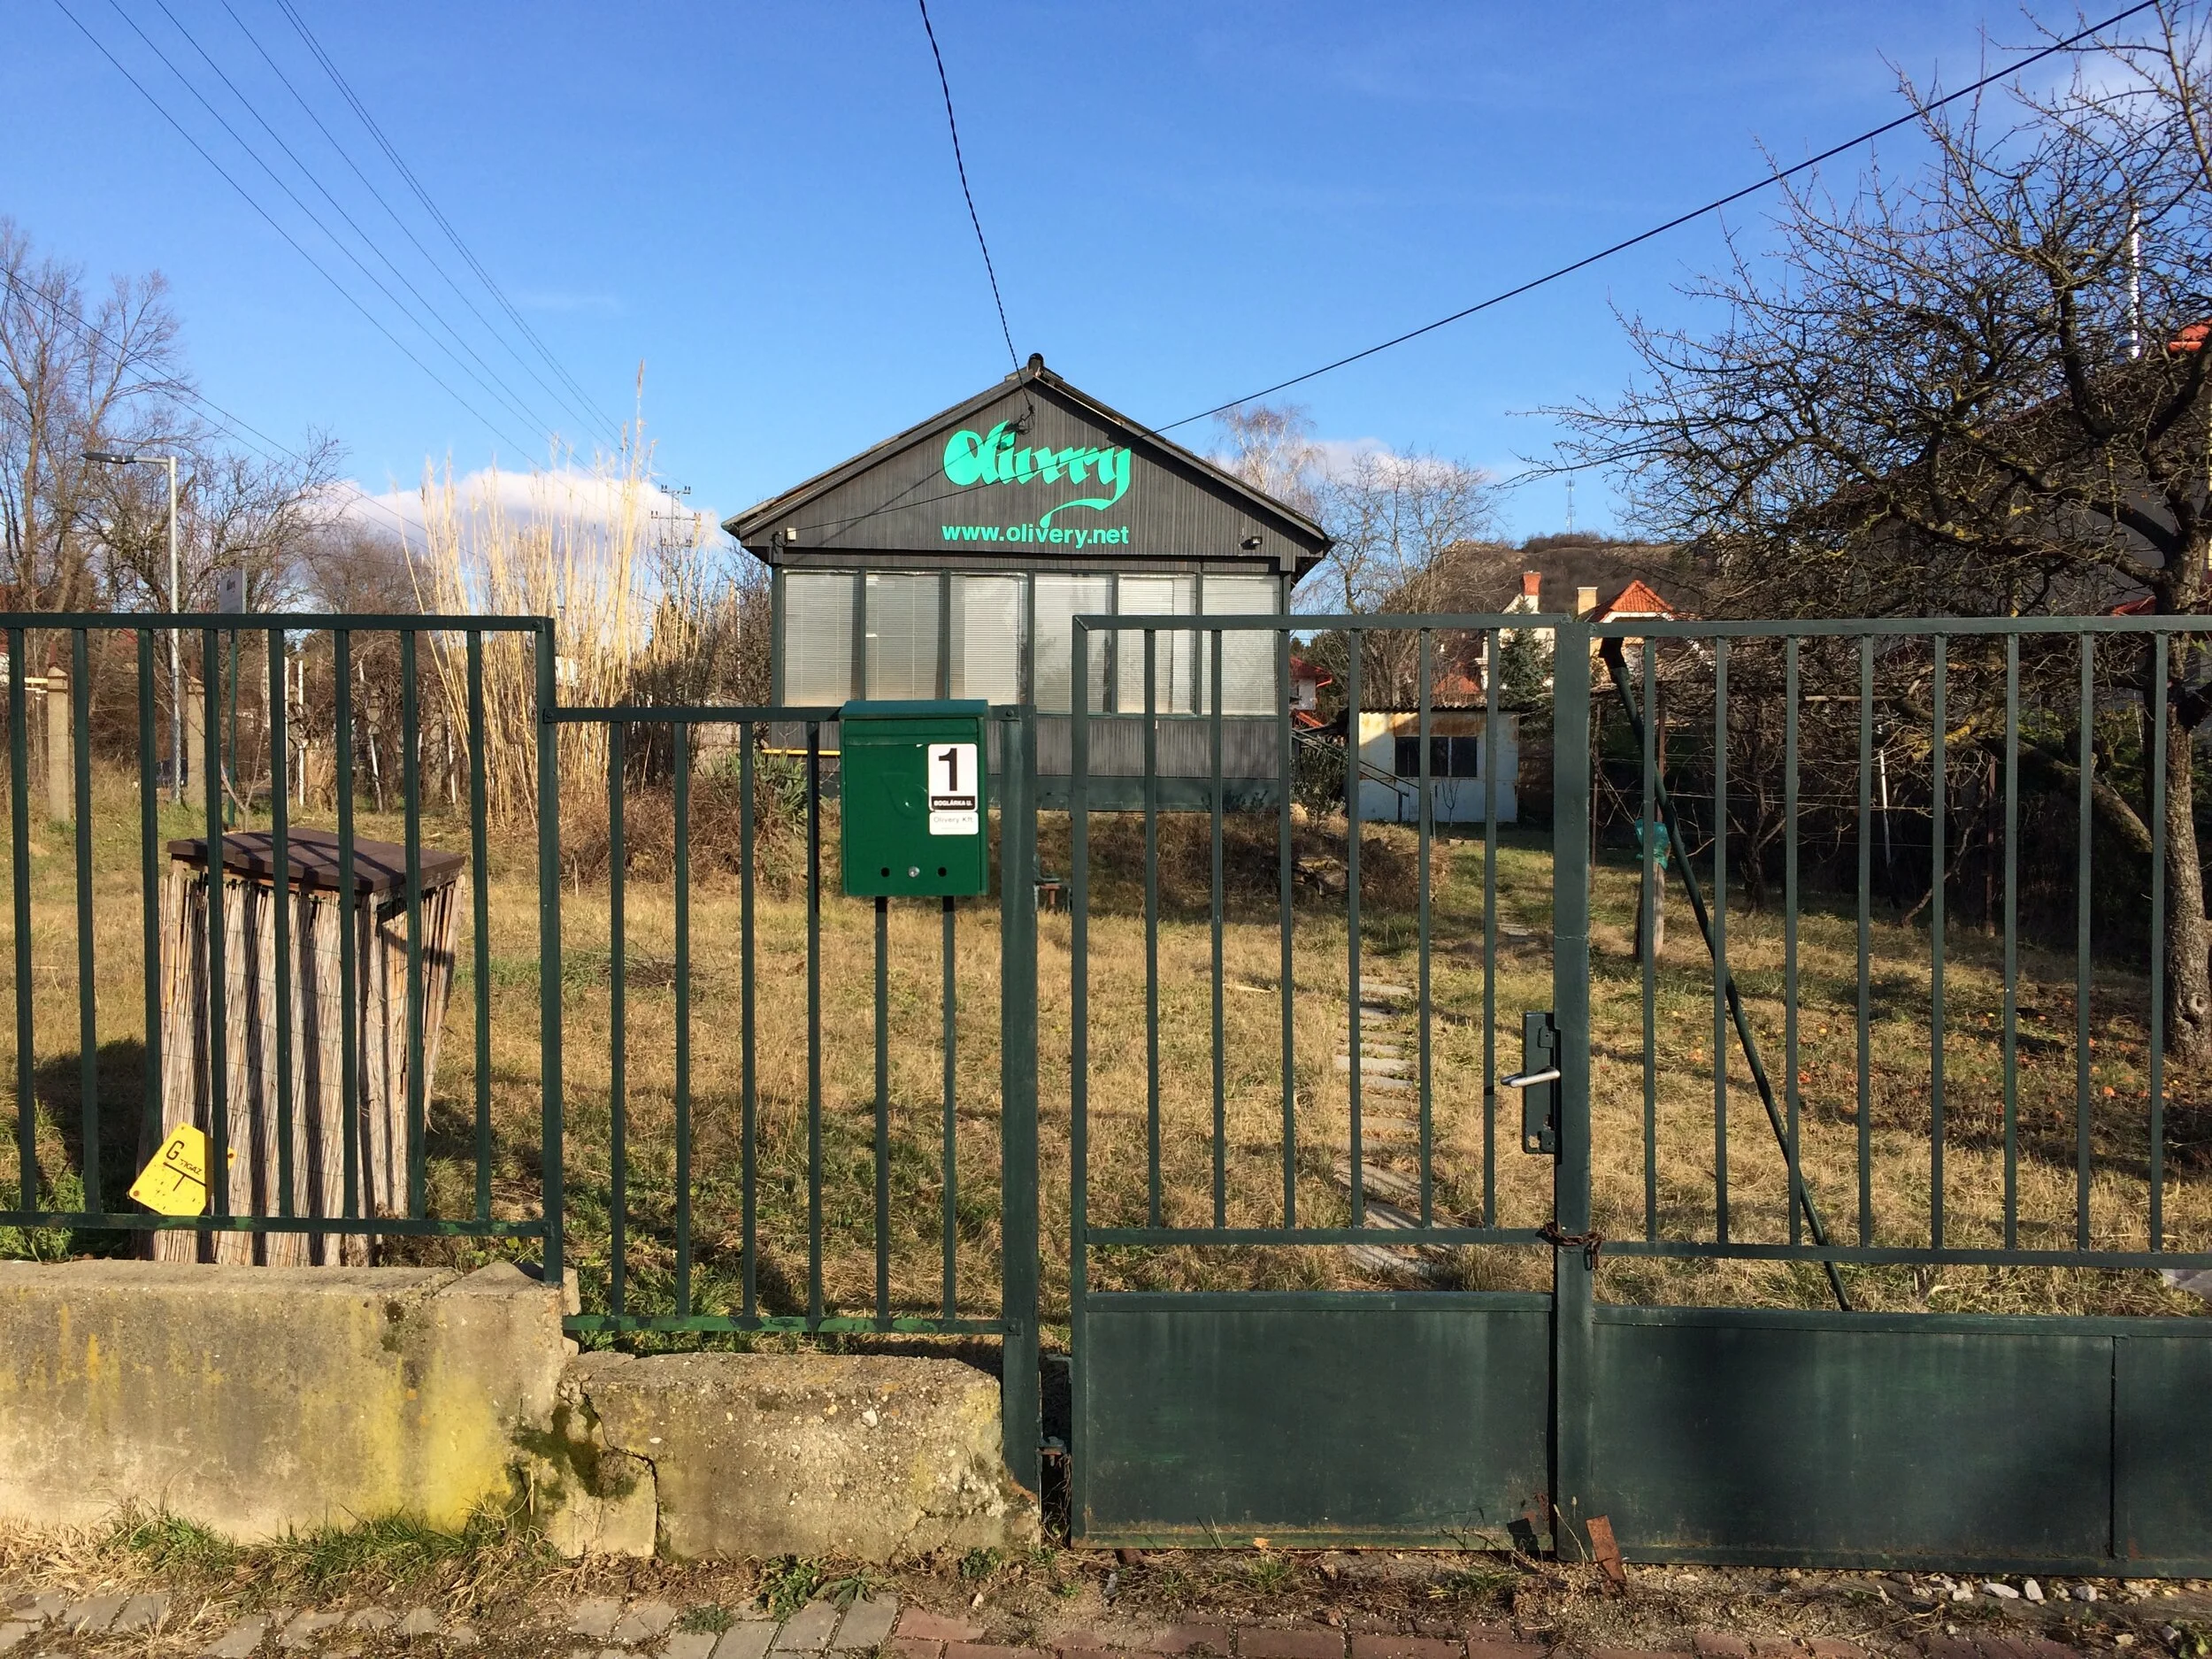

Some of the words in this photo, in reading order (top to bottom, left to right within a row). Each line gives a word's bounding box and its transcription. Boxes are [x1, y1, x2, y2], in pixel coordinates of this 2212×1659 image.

[941, 524, 1129, 549] www.olivery.net
[938, 748, 957, 791] 1
[166, 1141, 185, 1161] G
